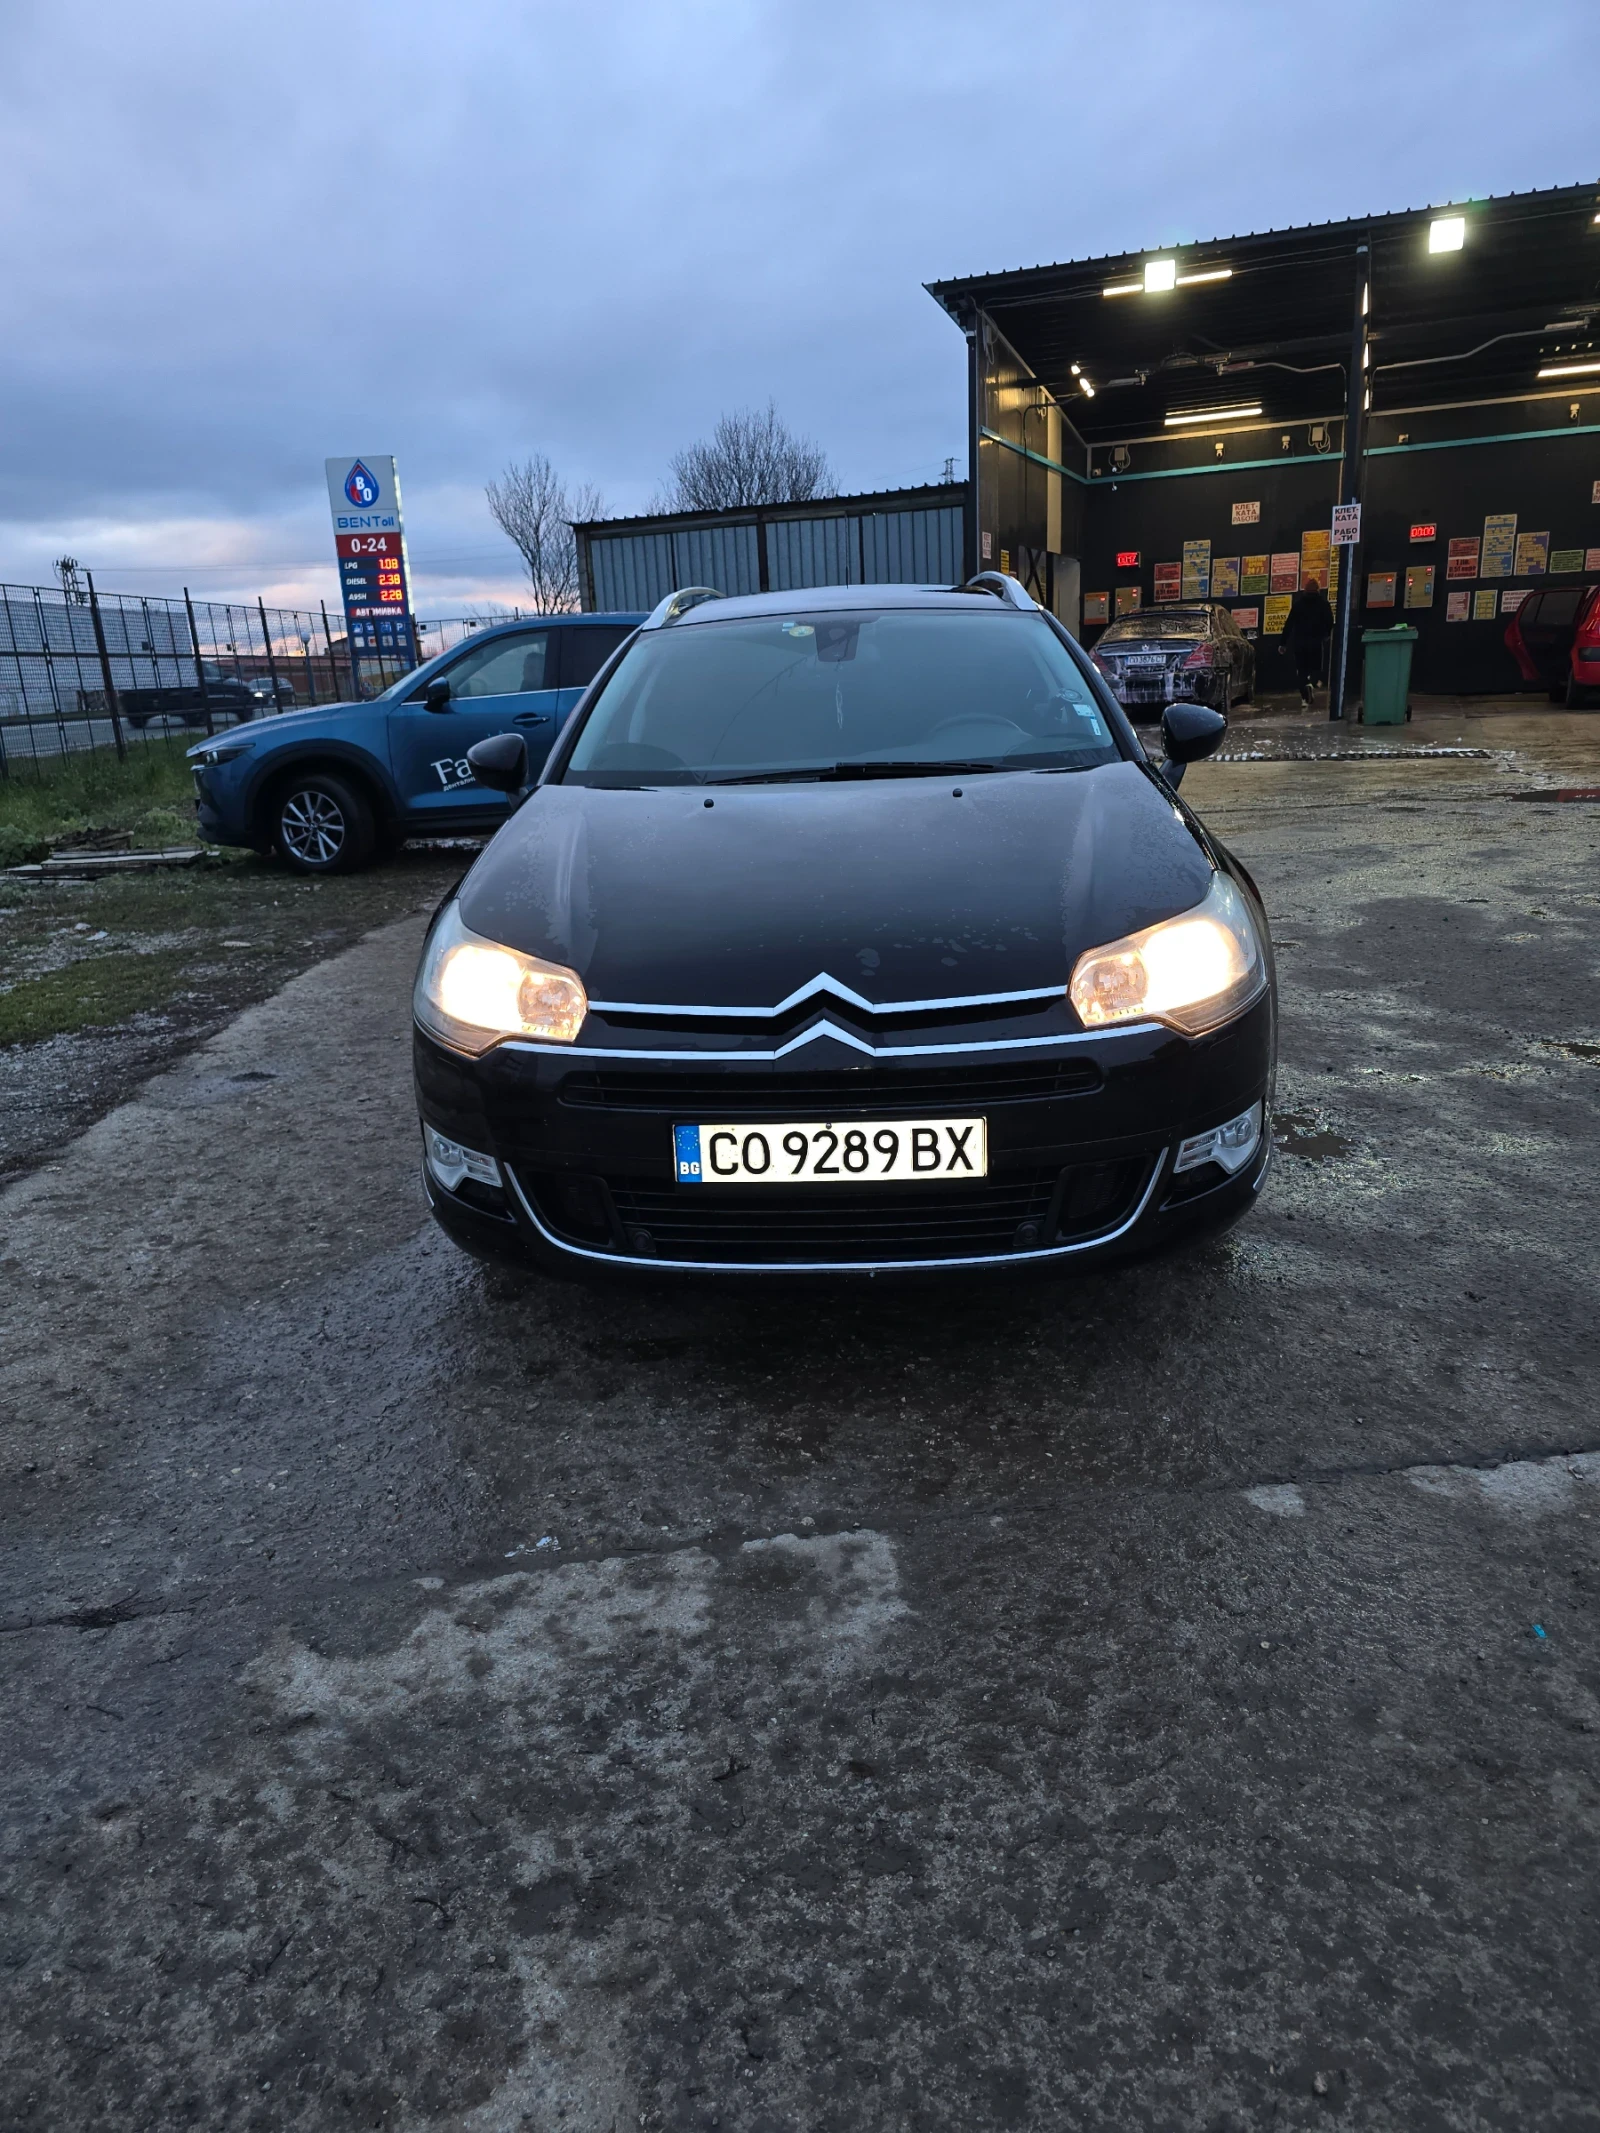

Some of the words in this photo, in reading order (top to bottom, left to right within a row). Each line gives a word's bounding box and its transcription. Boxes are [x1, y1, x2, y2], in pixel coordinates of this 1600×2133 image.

[1335, 506, 1359, 514] КЛЕТ-
[1335, 513, 1358, 521] КАТА
[1334, 528, 1358, 536] РАБО
[351, 537, 388, 553] 0-24
[344, 562, 358, 570] LPG
[346, 577, 367, 586] DIESEL
[379, 574, 401, 586] 2.38
[380, 589, 403, 602] 2.28
[782, 1129, 899, 1176] 9289
[911, 1126, 974, 1173] BX
[680, 1162, 700, 1175] BG
